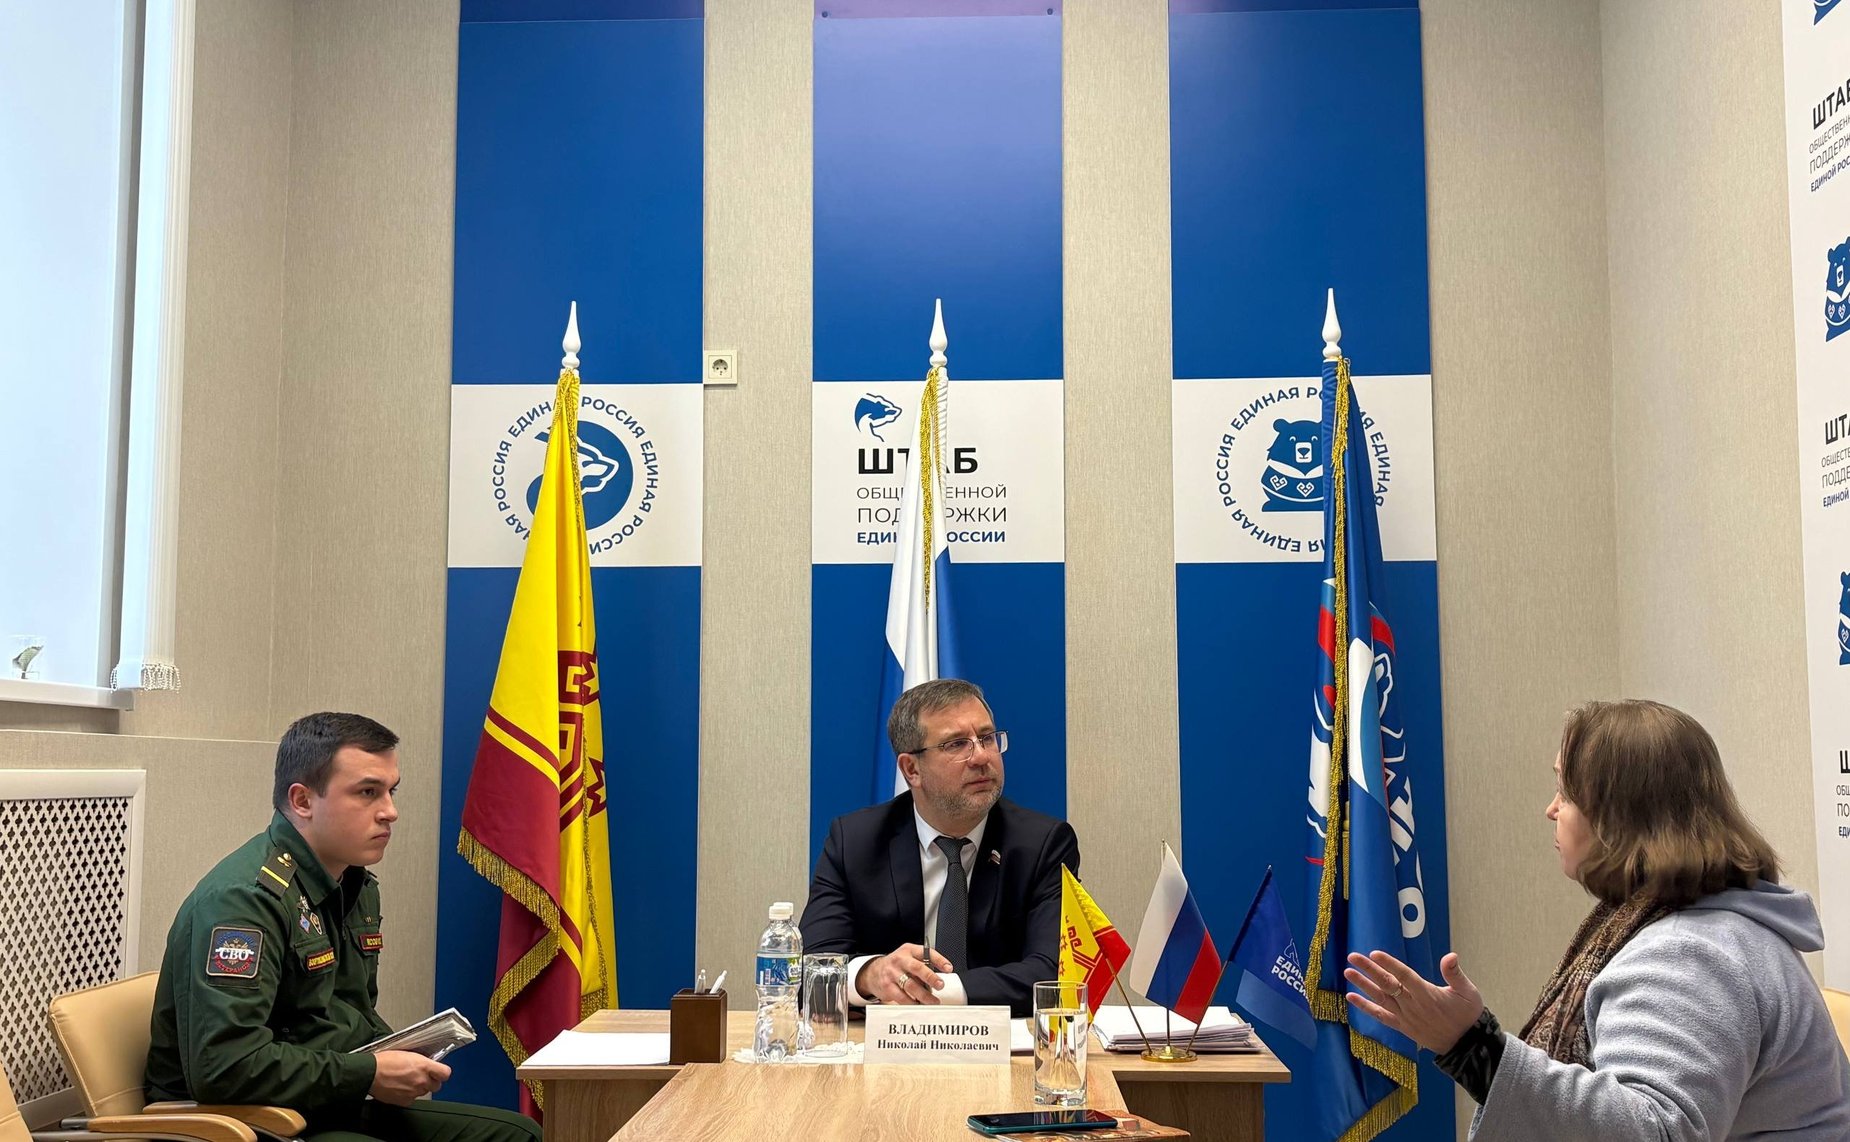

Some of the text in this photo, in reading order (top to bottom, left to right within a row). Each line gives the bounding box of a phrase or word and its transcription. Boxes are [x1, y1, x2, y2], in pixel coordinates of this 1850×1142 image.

[1810, 163, 1836, 192] ЕДИНОЙ
[1230, 387, 1300, 431] ЕДИНАЯ
[1825, 413, 1850, 445] ШТ
[492, 396, 659, 555] РОССИЯ ЕДИН РОССИЯ ЕДИНАЯ РОССИ
[1216, 433, 1236, 507] РОССИЯ
[856, 483, 1007, 502] ОБЩЕННОЙ
[1823, 486, 1850, 509] ЕДИНОЙ
[857, 531, 1006, 545] ЕДИ ОССИИ
[1231, 508, 1301, 553] ЕДИНАЯ
[219, 948, 249, 961] СВО
[1275, 955, 1304, 982] ЕДИН
[1271, 965, 1309, 1001] РОССИ
[888, 1023, 990, 1036] ВЛАДИМИРОВ
[877, 1039, 999, 1051] Николай Николаевич
